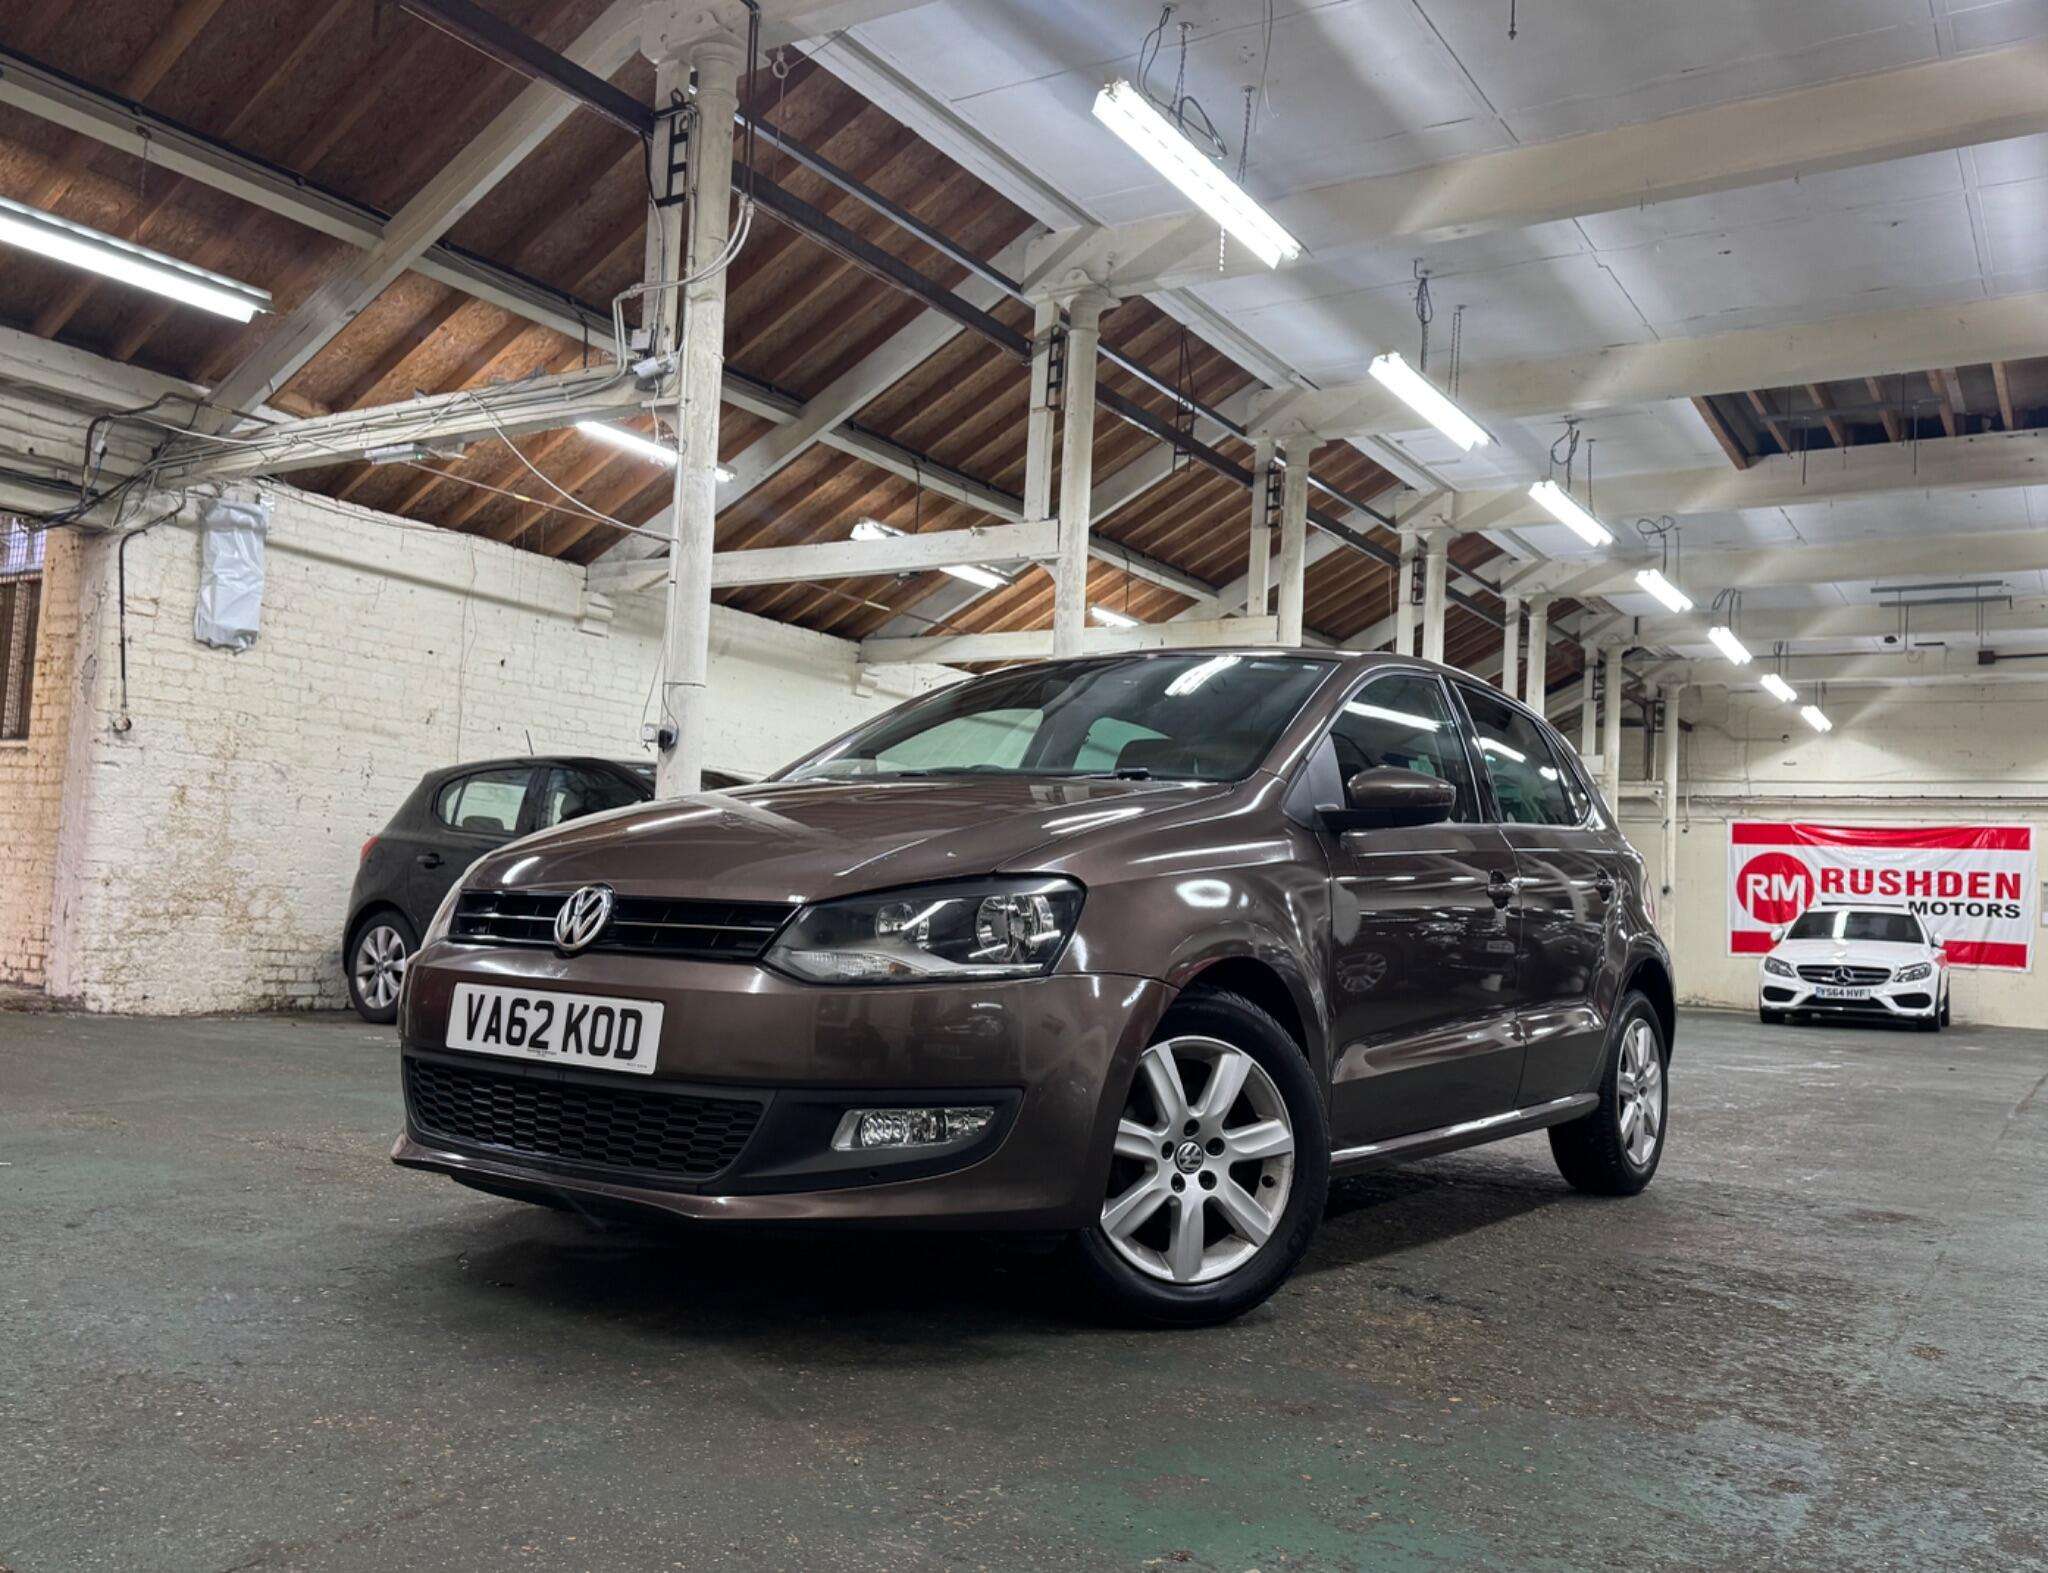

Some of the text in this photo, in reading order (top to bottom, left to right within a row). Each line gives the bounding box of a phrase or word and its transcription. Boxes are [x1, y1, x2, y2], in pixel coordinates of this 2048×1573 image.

[1746, 873, 1806, 903] RM
[1820, 867, 2022, 900] RUSHDEN
[1908, 901, 2021, 919] MOTORS
[466, 993, 643, 1061] VA62 KOD
